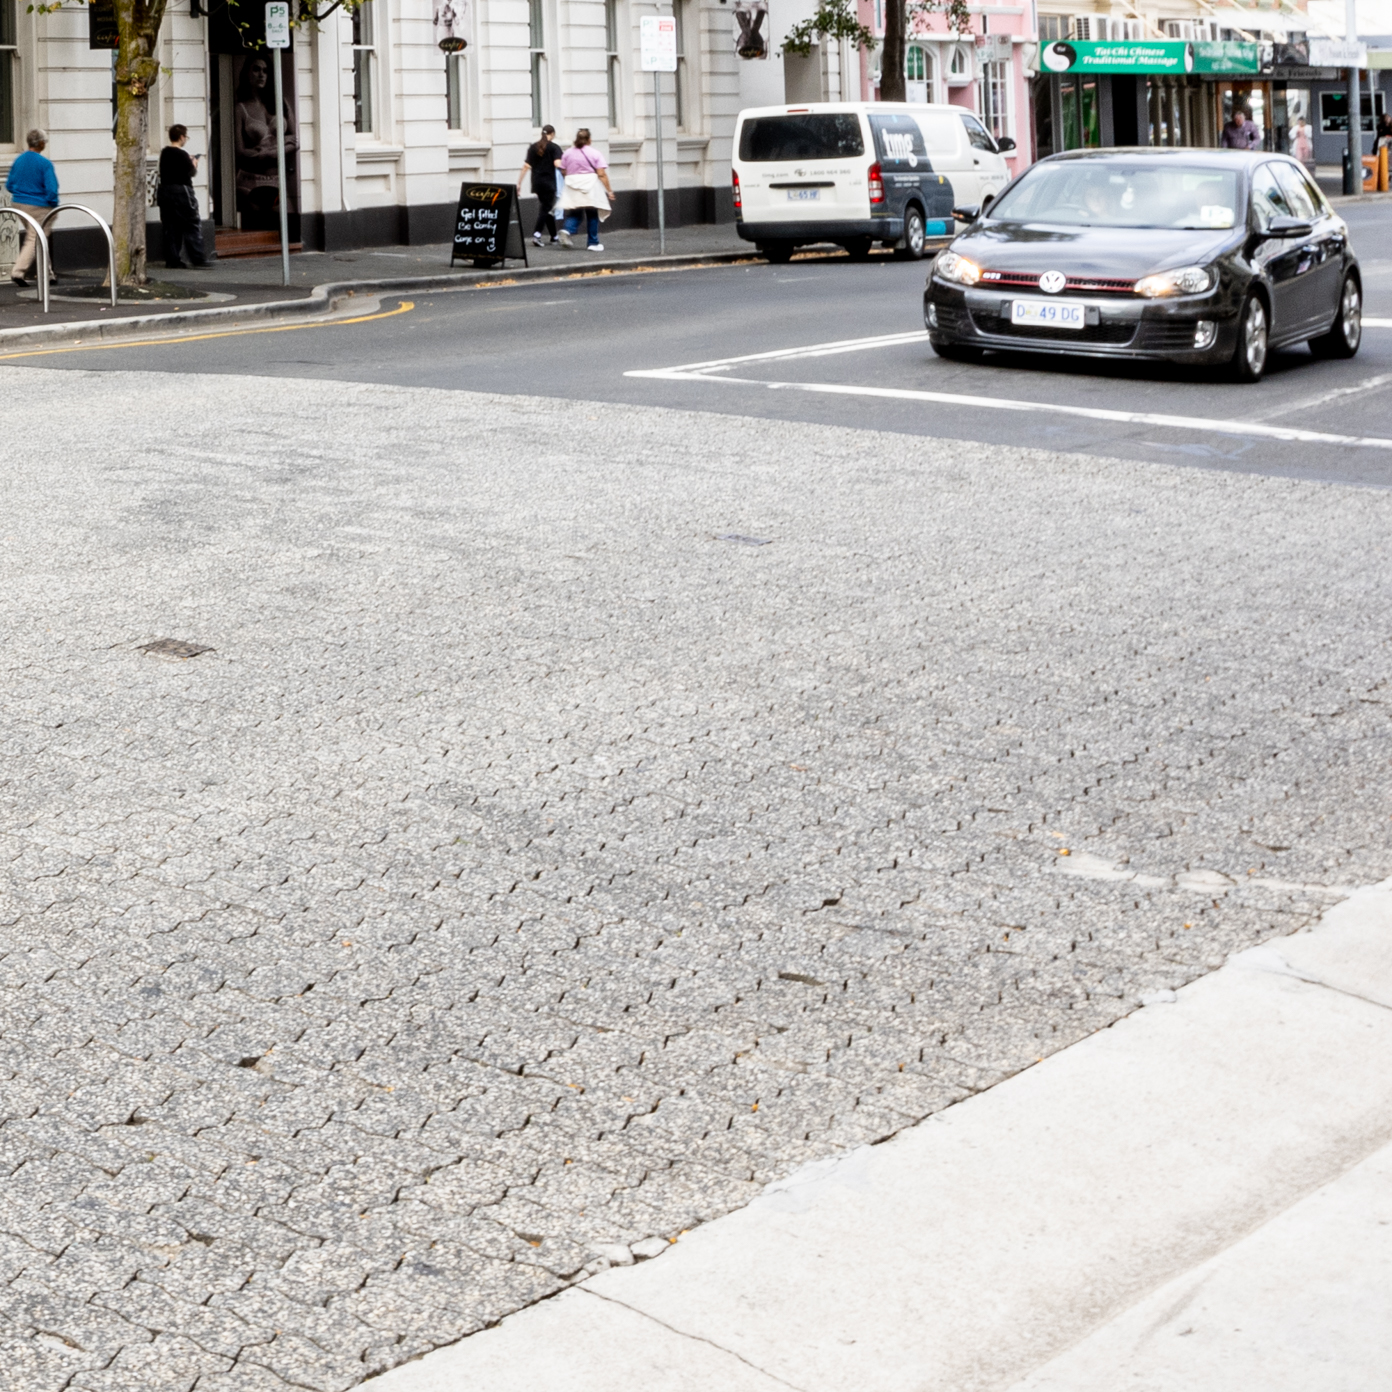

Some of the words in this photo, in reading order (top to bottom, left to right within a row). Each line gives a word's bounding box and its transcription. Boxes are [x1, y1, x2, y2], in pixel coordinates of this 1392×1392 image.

[1129, 47, 1166, 57] Chinese
[1082, 55, 1137, 65] Traditional
[1136, 56, 1178, 67] Massage
[1016, 304, 1026, 318] D
[1039, 306, 1057, 320] 49
[1061, 307, 1080, 321] DG
